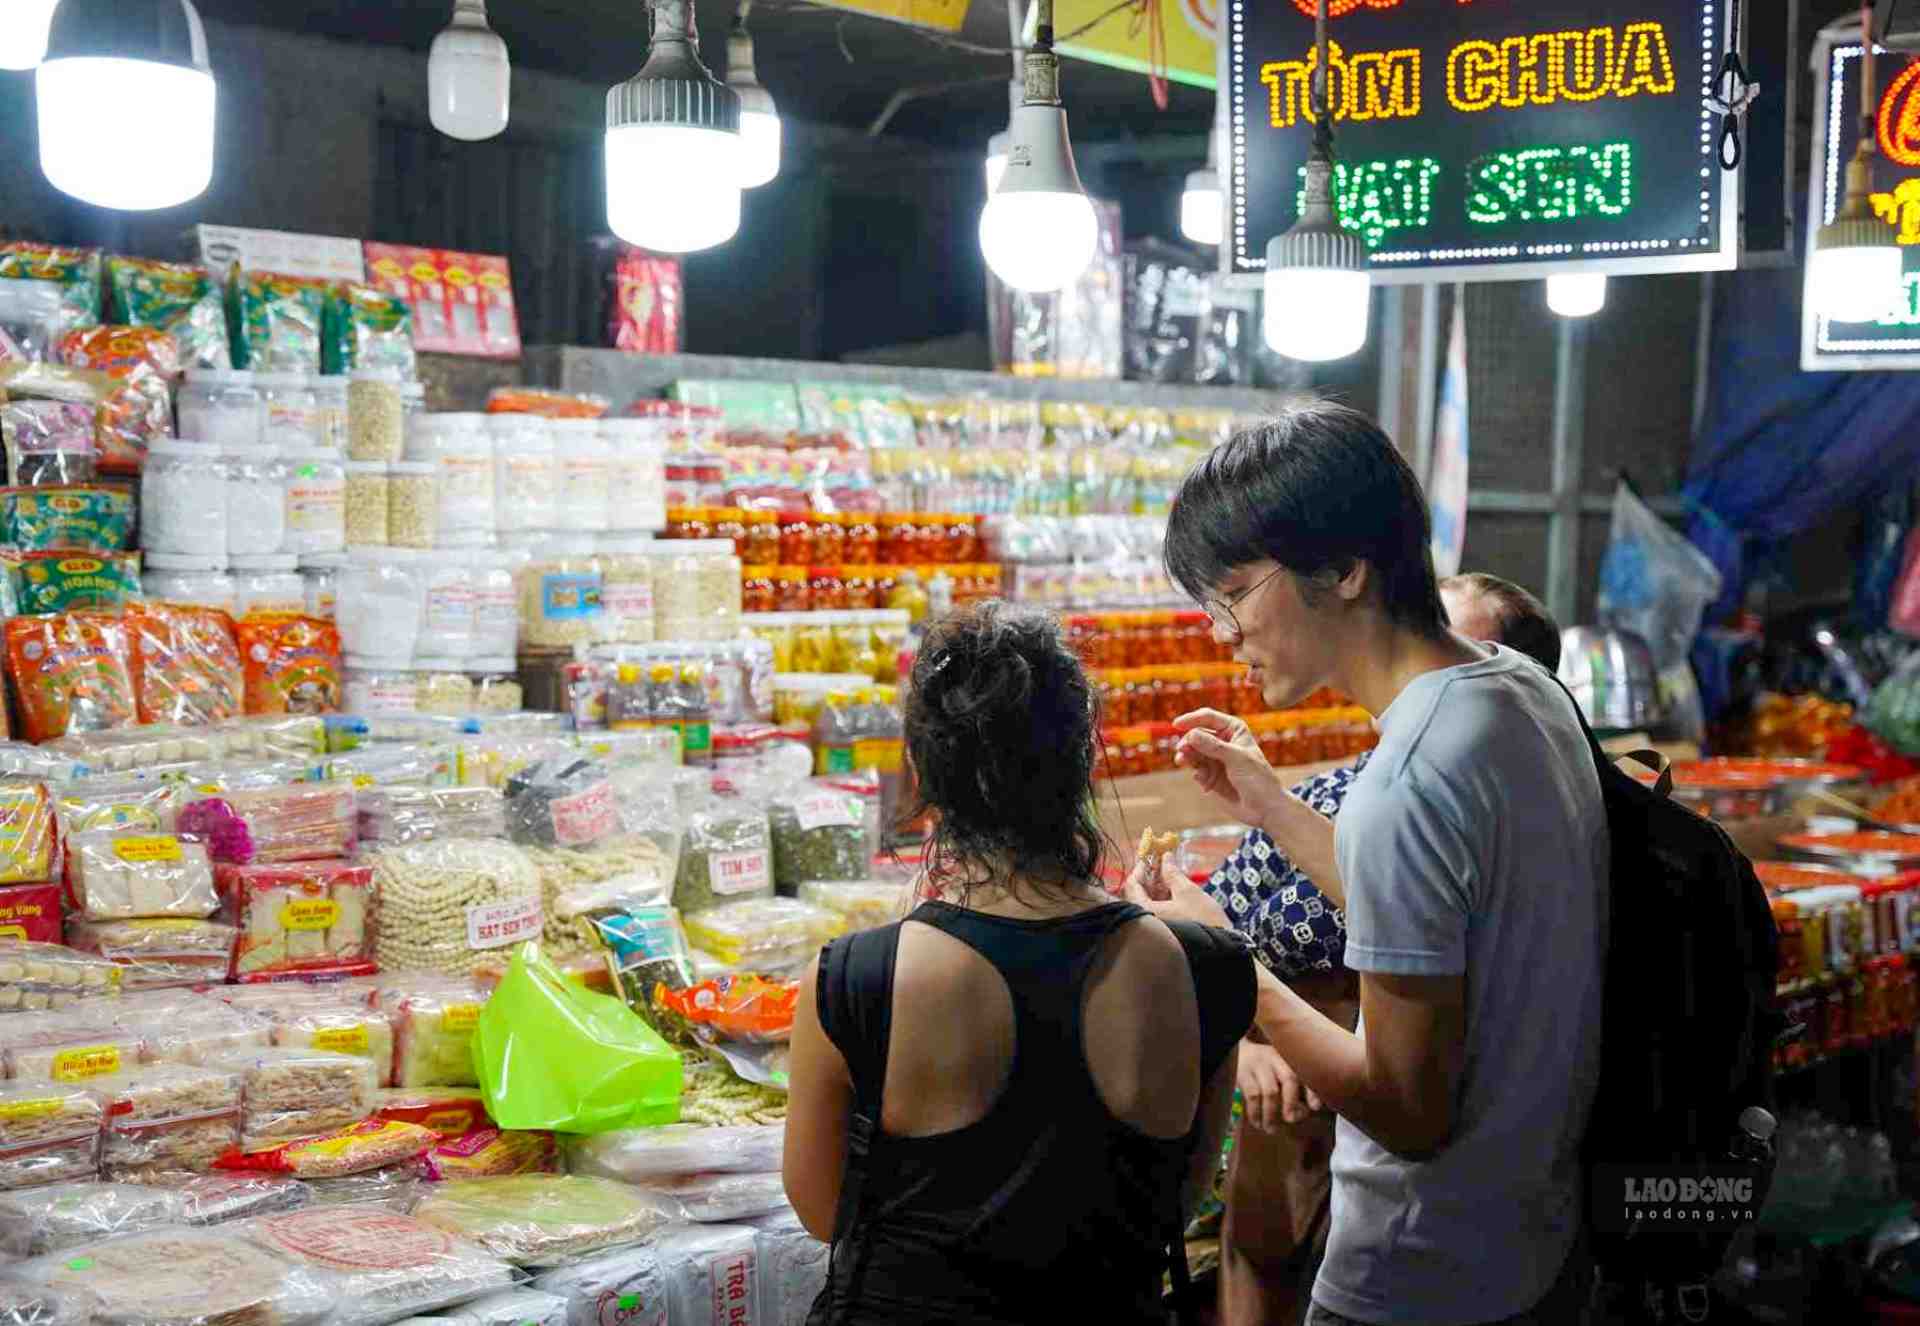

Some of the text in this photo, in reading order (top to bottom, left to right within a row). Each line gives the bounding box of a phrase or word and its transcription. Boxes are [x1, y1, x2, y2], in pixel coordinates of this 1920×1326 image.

[1261, 22, 1677, 128] TÔM CHUA
[1465, 142, 1633, 222] SEN
